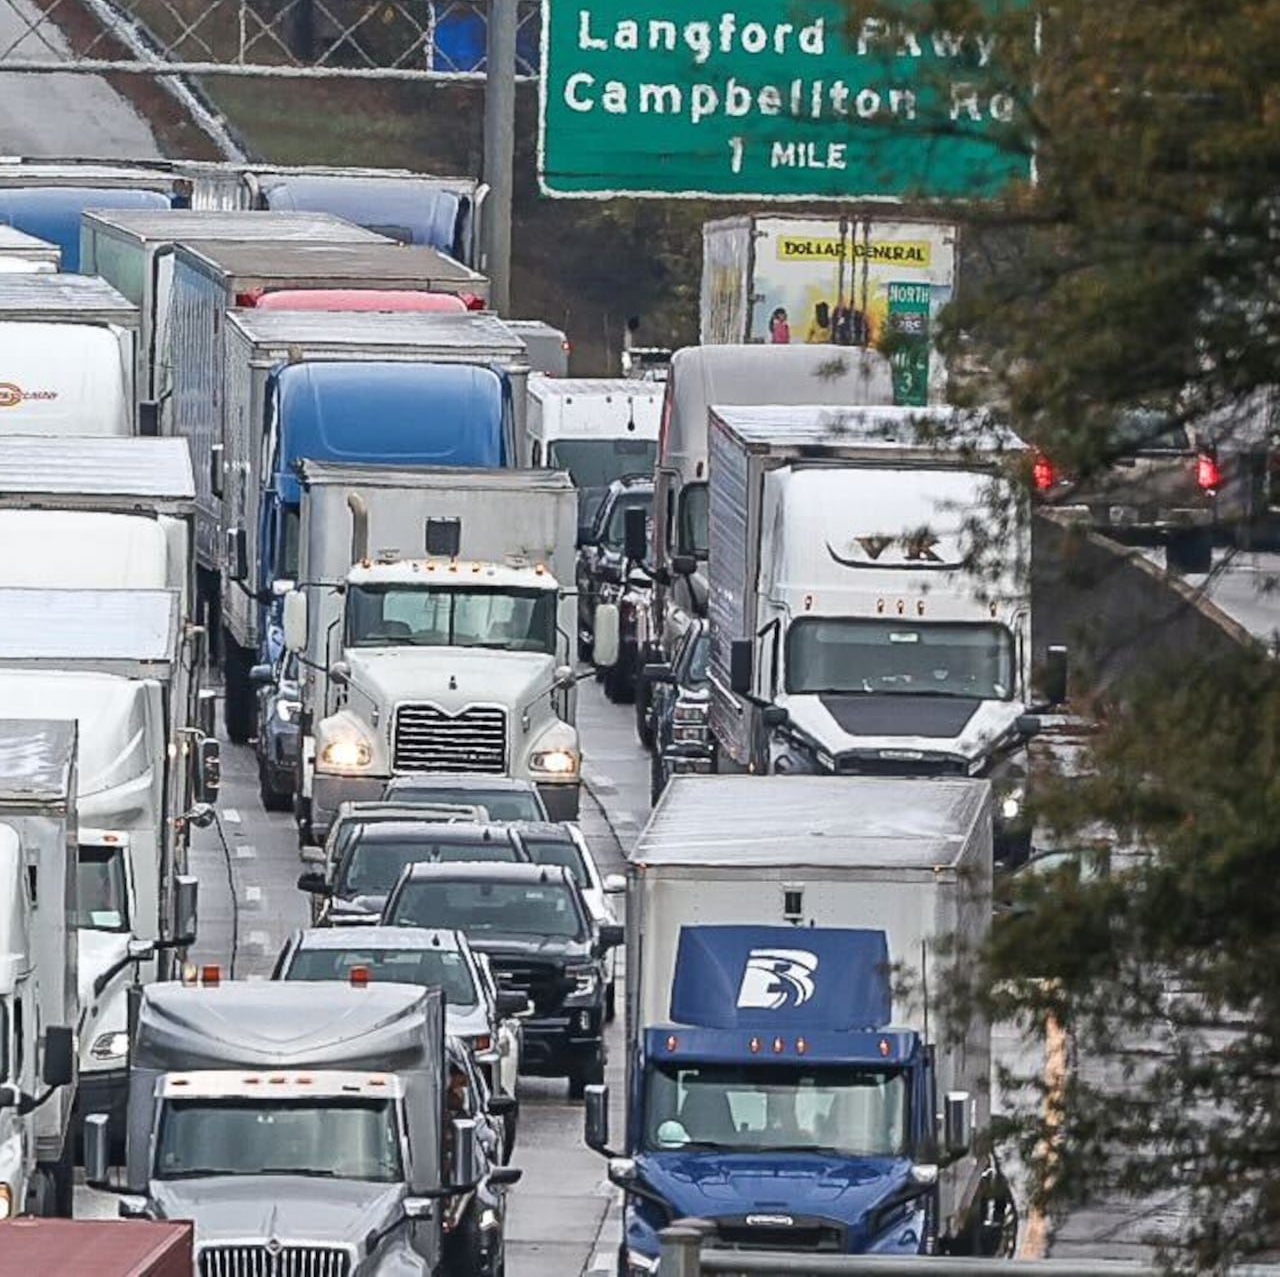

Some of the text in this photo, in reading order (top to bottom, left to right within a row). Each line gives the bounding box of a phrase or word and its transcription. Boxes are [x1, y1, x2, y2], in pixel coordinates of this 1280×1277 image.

[578, 10, 825, 64] Langford
[563, 71, 916, 123] Campbellton
[728, 136, 849, 173] 1 MILE
[890, 284, 929, 303] NORTH
[899, 371, 913, 393] 3
